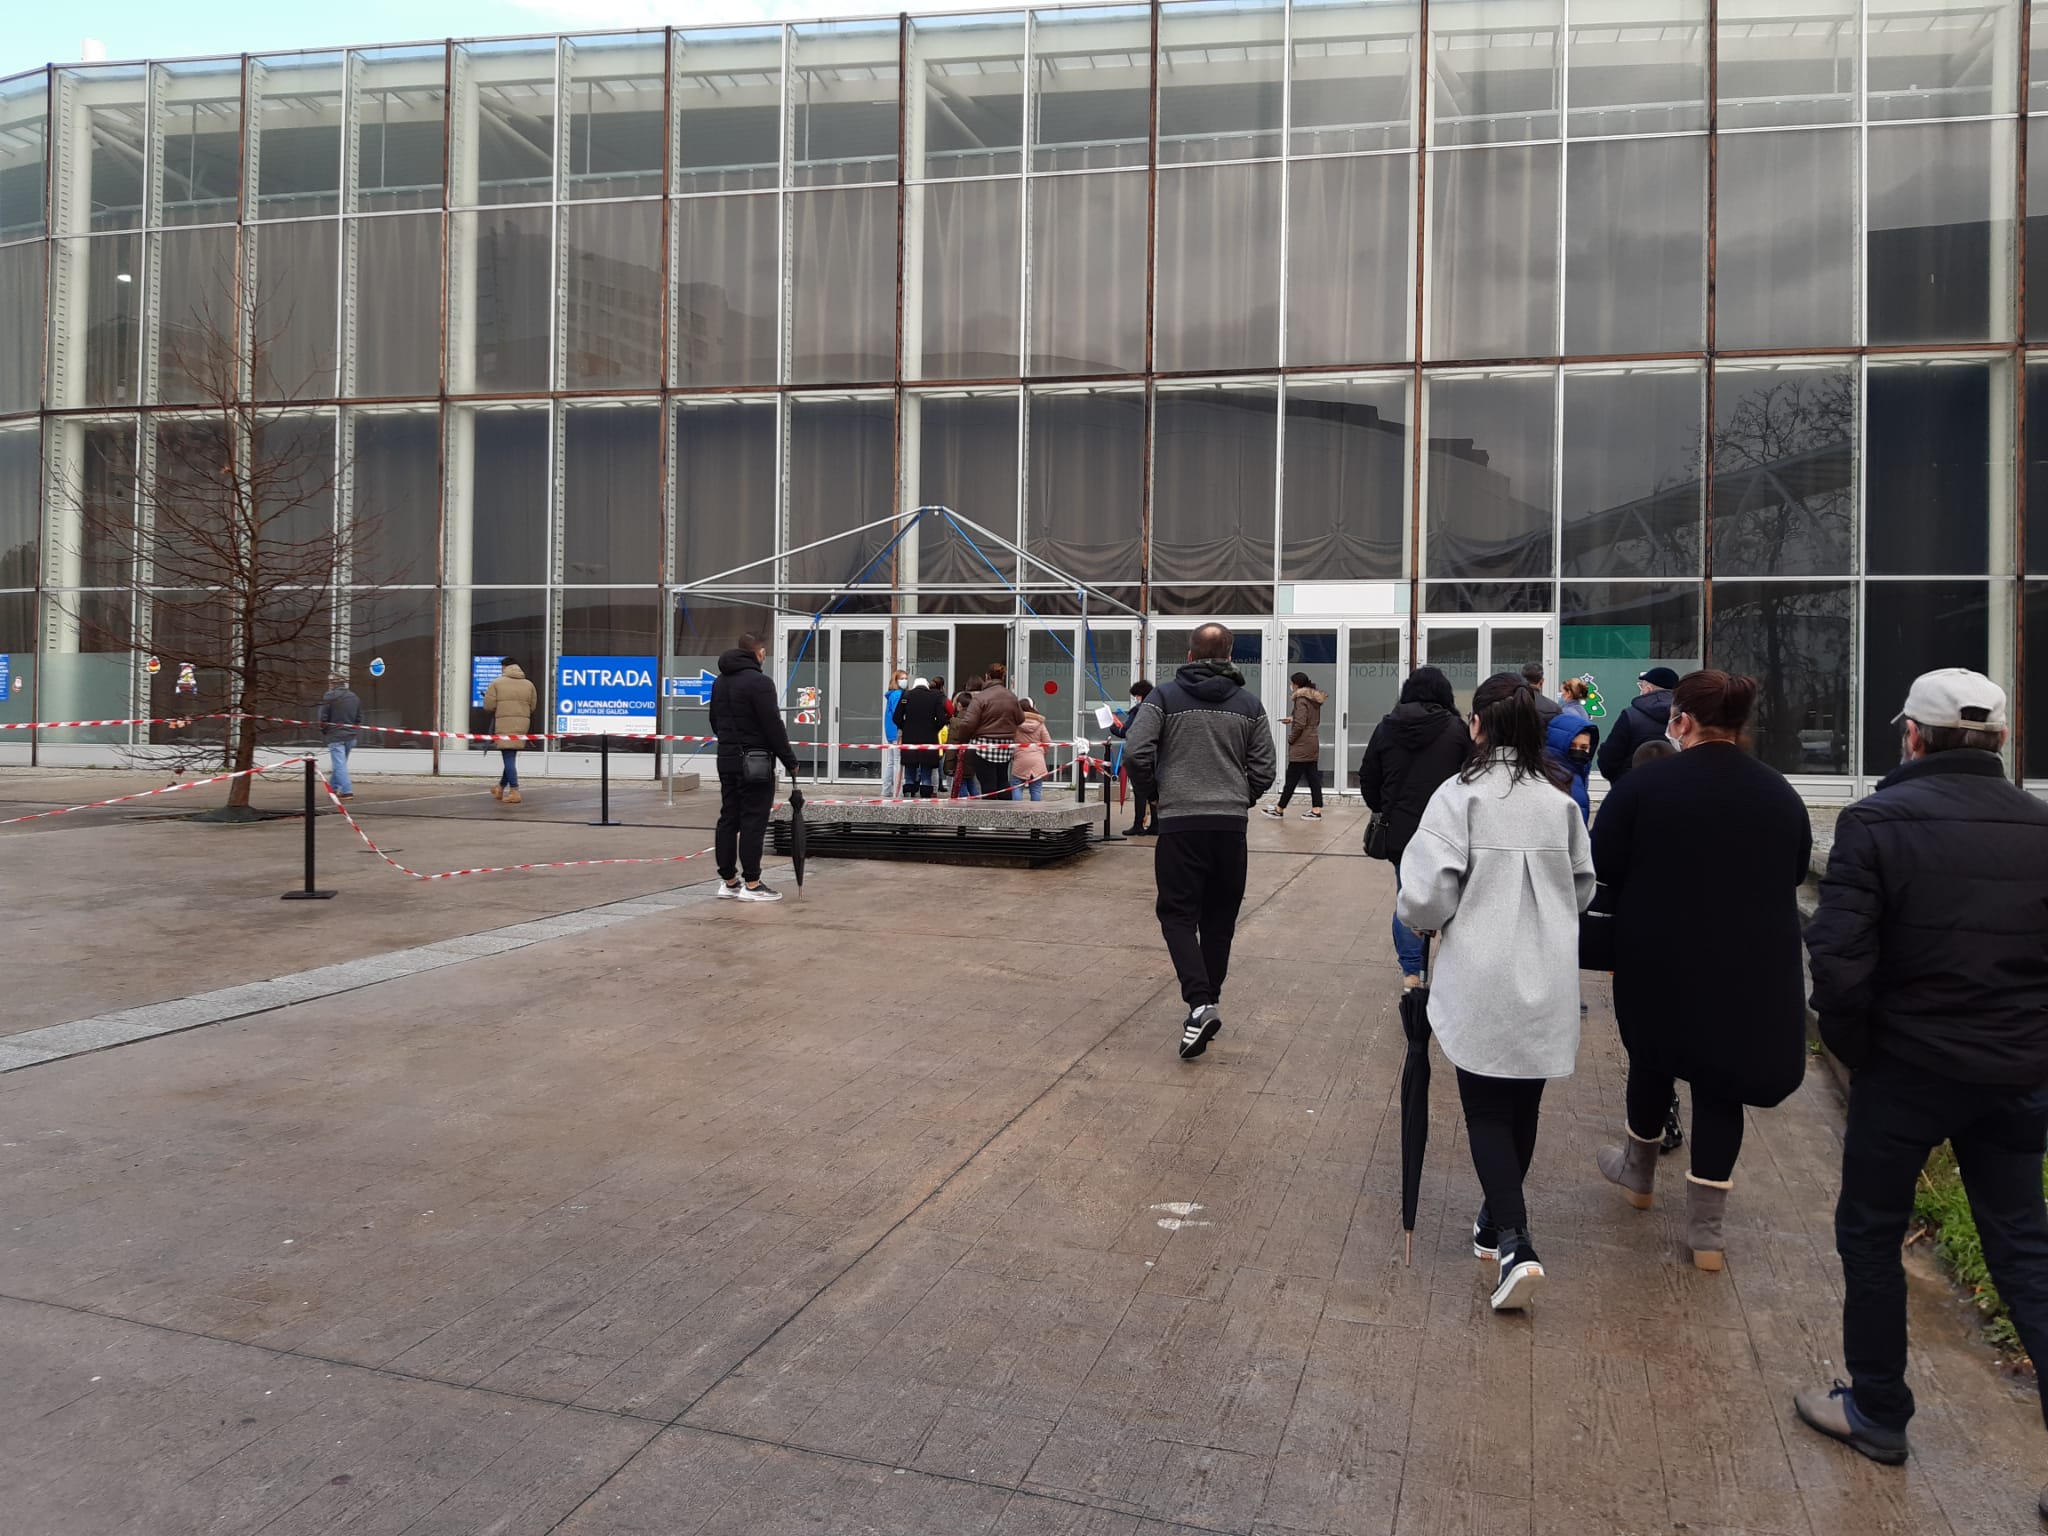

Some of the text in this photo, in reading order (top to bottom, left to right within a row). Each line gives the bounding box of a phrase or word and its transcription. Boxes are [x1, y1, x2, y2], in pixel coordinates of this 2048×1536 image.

[562, 669, 653, 687] ENTRADA
[577, 699, 656, 709] VACINACIÓN COVID
